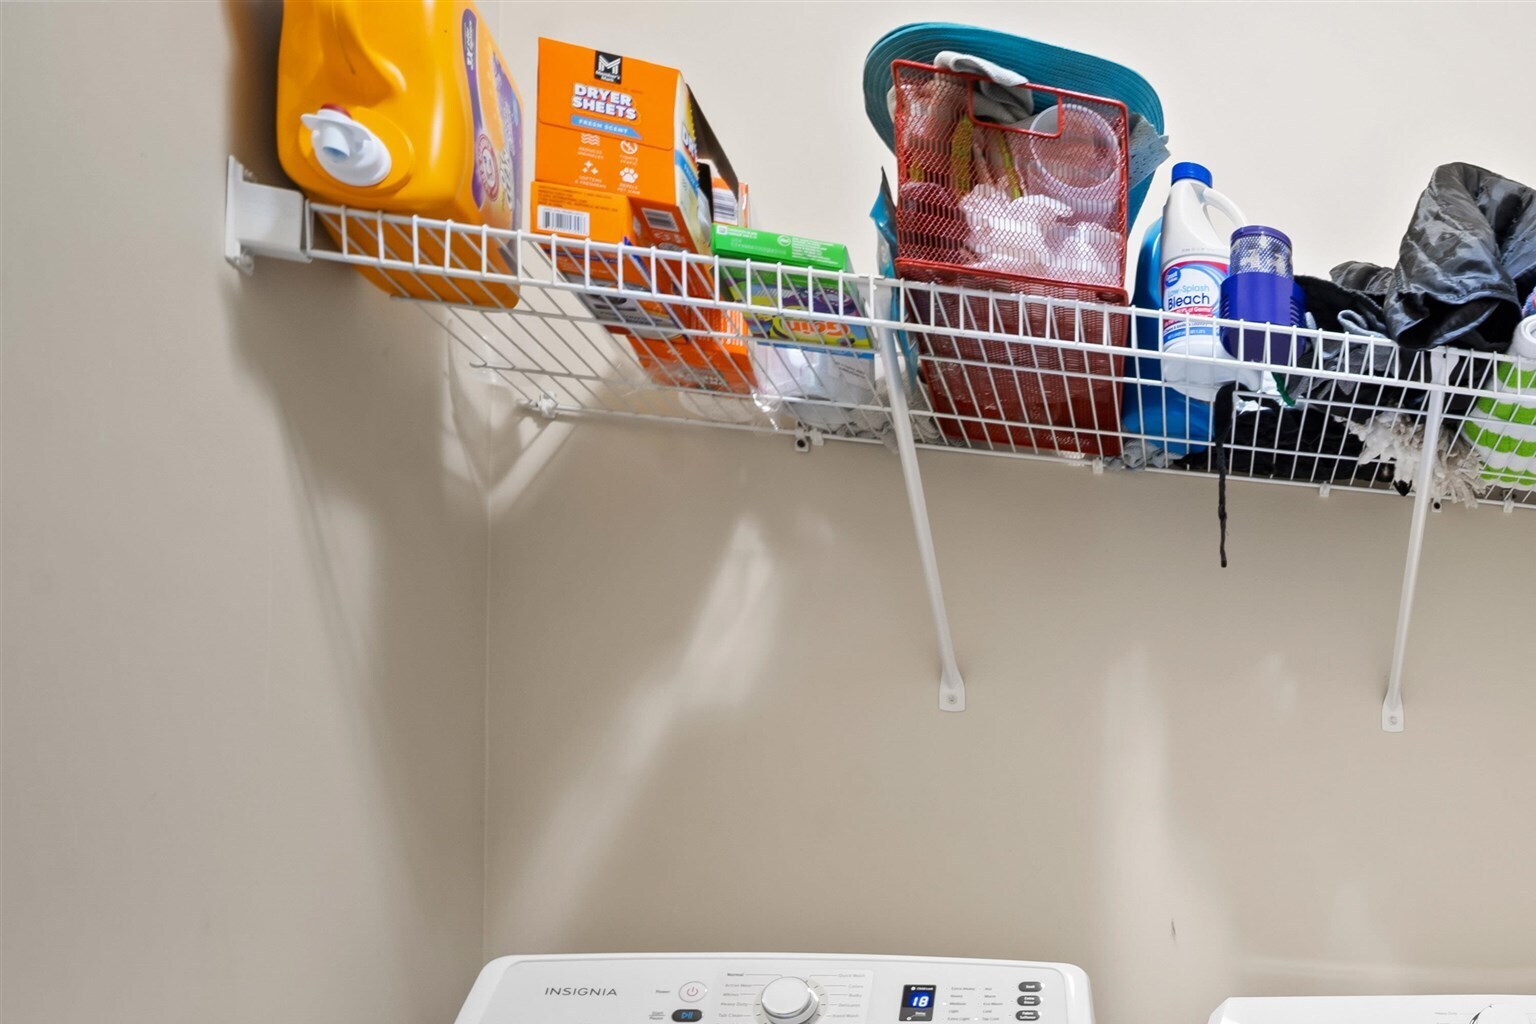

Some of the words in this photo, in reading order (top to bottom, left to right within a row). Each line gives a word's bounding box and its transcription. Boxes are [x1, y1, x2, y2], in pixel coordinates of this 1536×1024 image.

[574, 83, 632, 107] DRYER
[572, 96, 636, 120] SHEETS
[578, 118, 602, 128] FRESH
[604, 124, 628, 135] SCENT
[1168, 292, 1210, 310] Bleach
[545, 987, 617, 996] INSIGNIA
[913, 996, 929, 1007] 18
